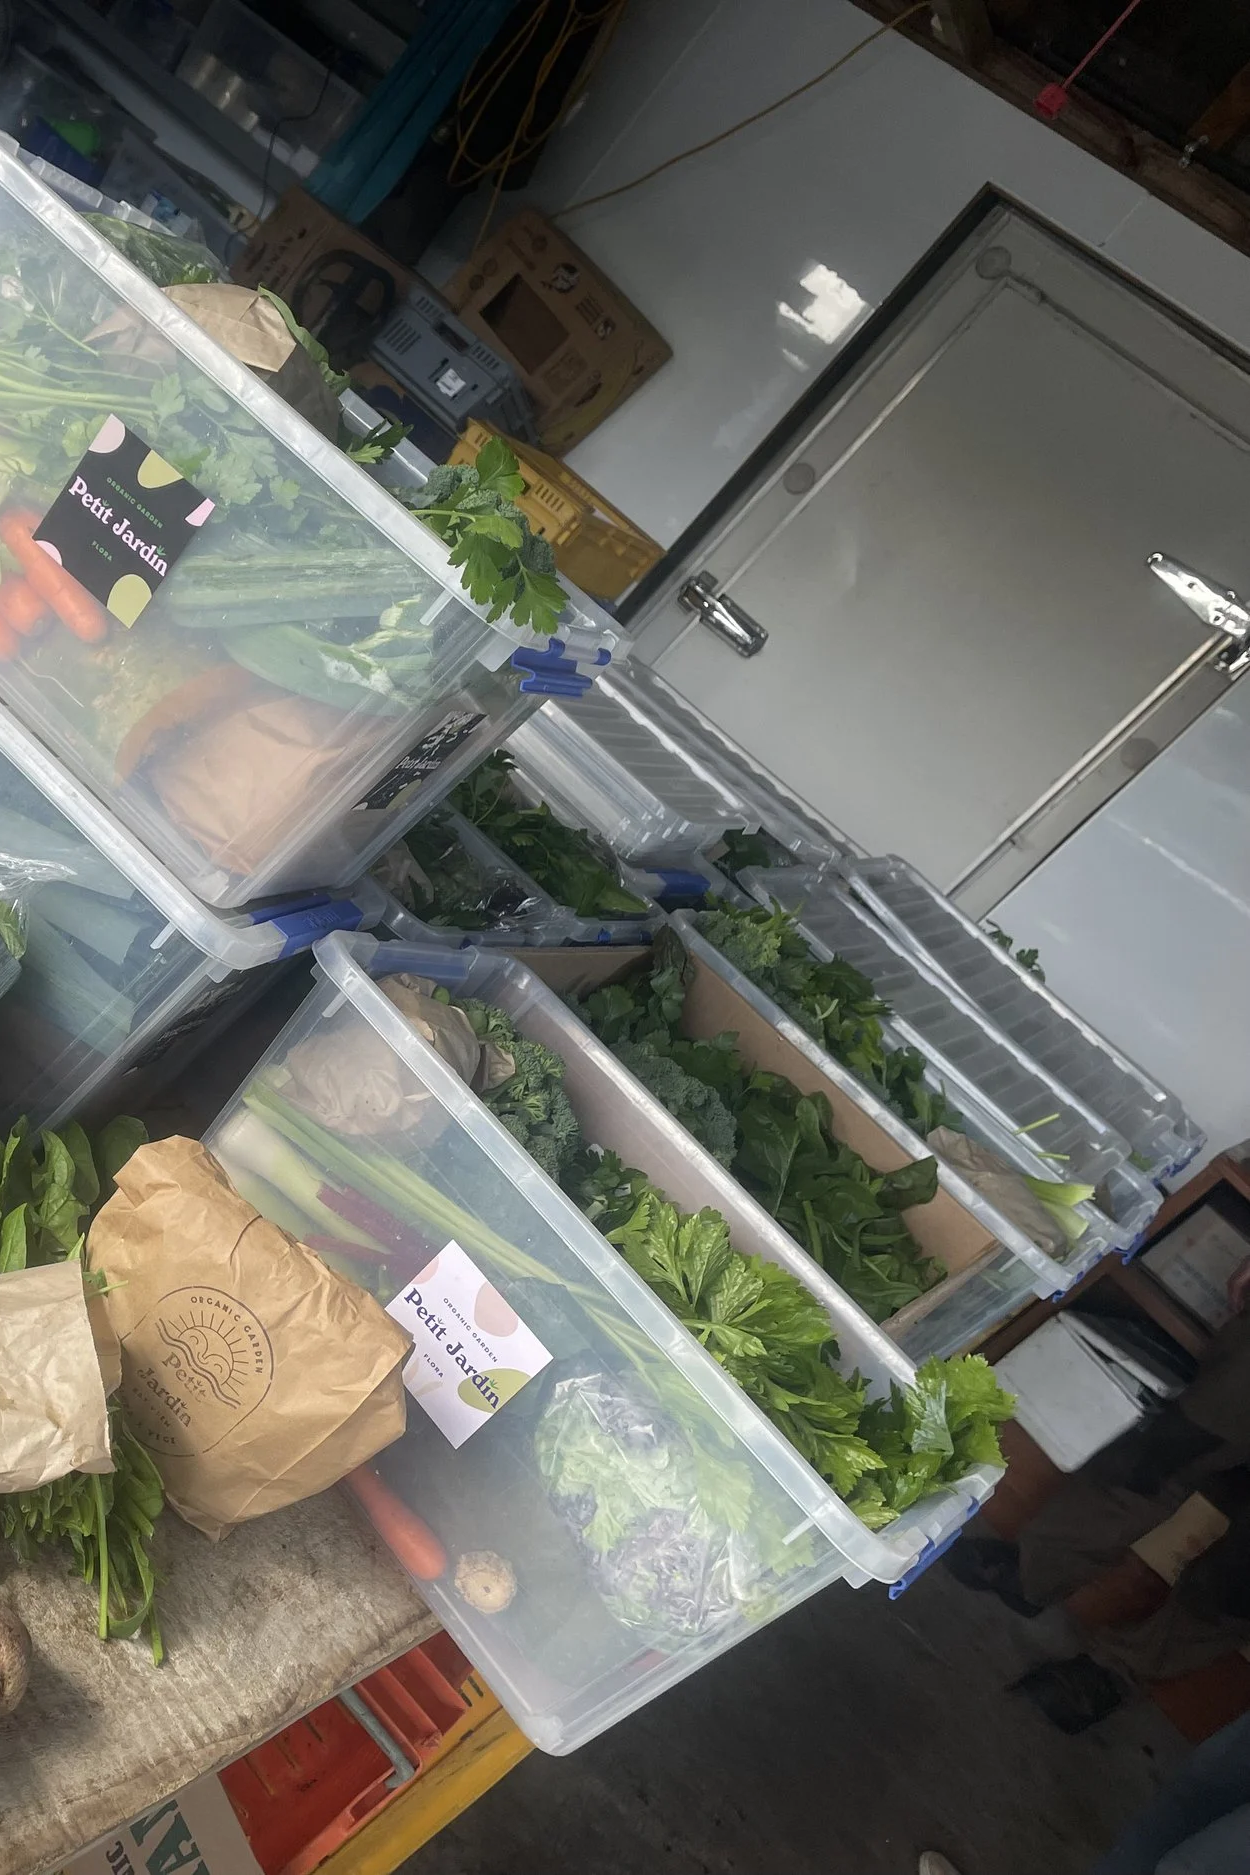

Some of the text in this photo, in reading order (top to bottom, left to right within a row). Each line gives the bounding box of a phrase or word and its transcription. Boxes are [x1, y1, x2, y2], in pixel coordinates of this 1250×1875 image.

[68, 475, 169, 577] Petit Jardin
[106, 476, 164, 529] ORGANIC GARDEN
[91, 540, 113, 562] FLORA
[190, 1296, 264, 1374] ORGANIC GARDEN
[403, 1287, 501, 1409] Petit Jardin
[443, 1297, 499, 1363] ORGANIC GARDEN
[161, 1352, 207, 1403] Petit
[423, 1353, 444, 1378] FLORA
[136, 1367, 192, 1427] Jardin
